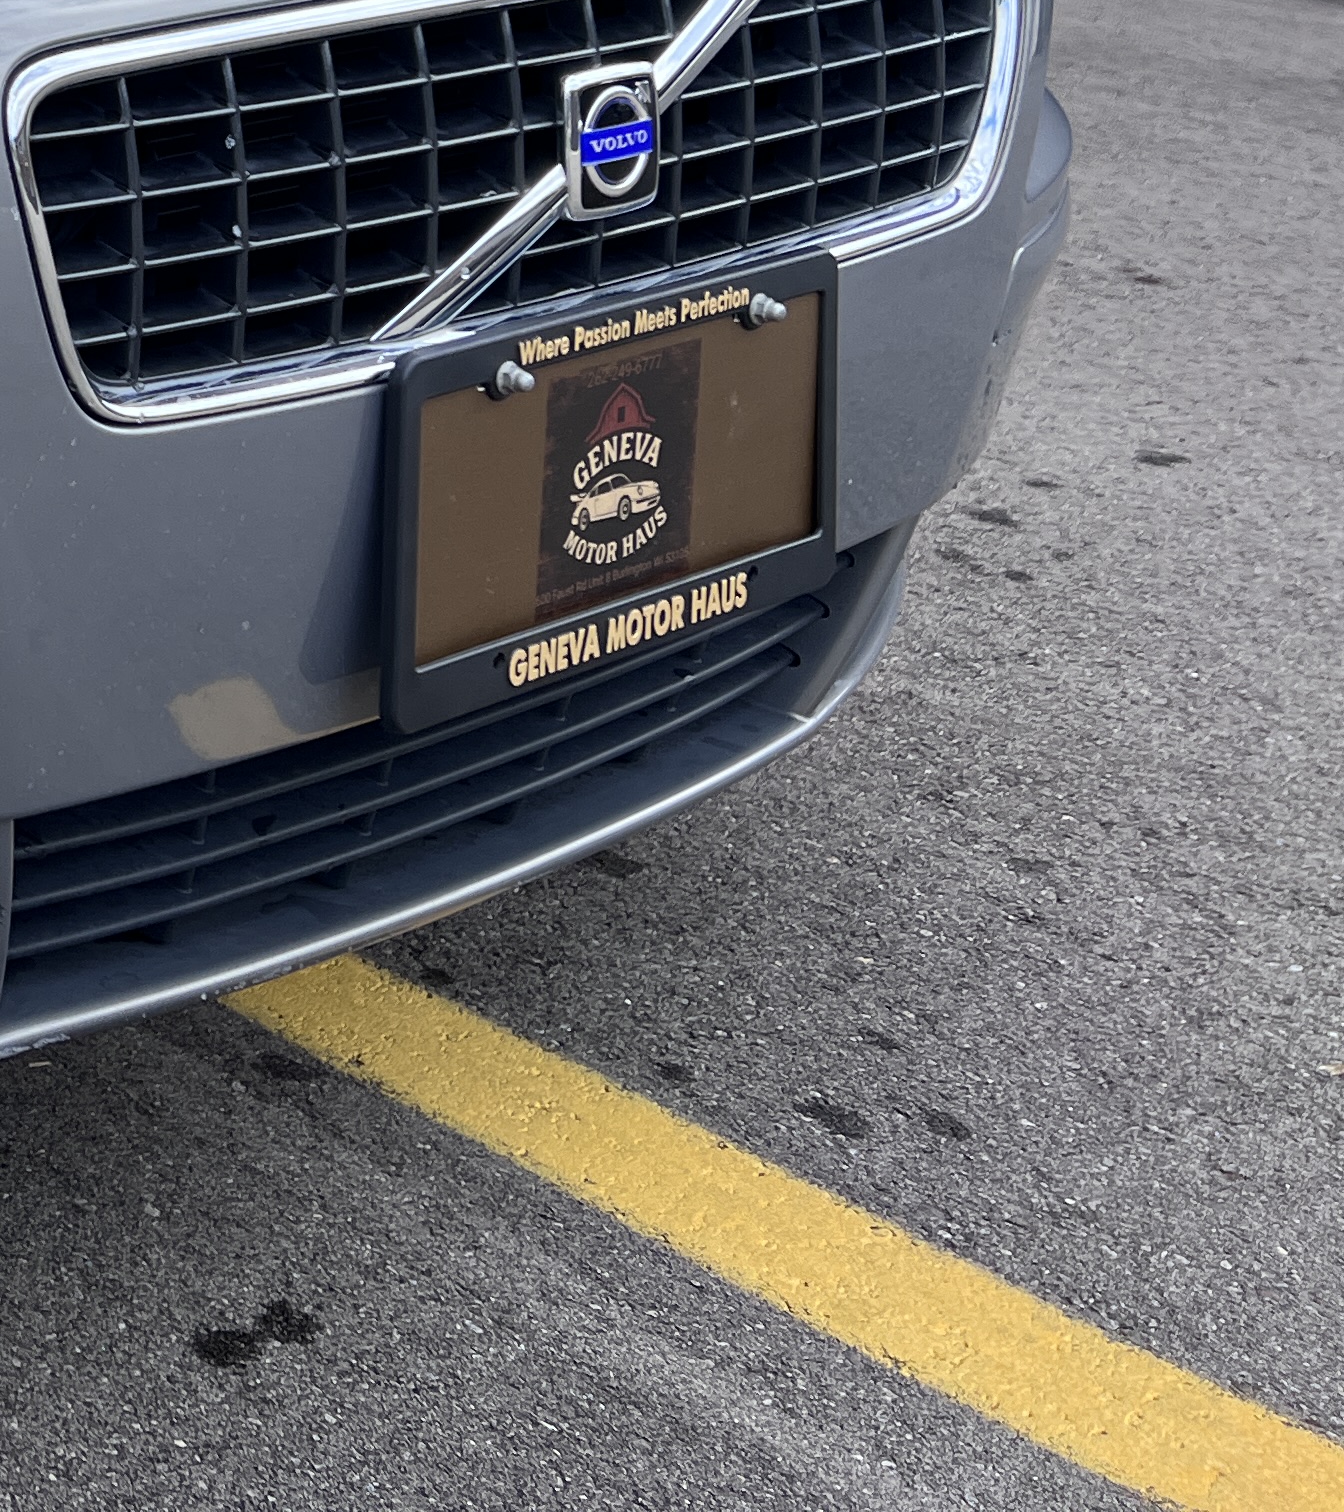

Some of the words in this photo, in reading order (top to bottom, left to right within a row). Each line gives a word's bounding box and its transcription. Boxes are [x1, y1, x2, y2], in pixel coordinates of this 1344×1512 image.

[589, 129, 649, 154] VOLVO
[518, 335, 570, 366] Where
[574, 317, 631, 352] Passion
[634, 306, 677, 335] Meets
[680, 286, 750, 323] Perfection
[573, 431, 663, 490] GENEVA
[562, 529, 618, 565] MOTOR
[621, 505, 668, 558] HAUS
[508, 623, 601, 687] GENEVA
[605, 595, 686, 654] MOTOR
[690, 572, 748, 624] HAUS
